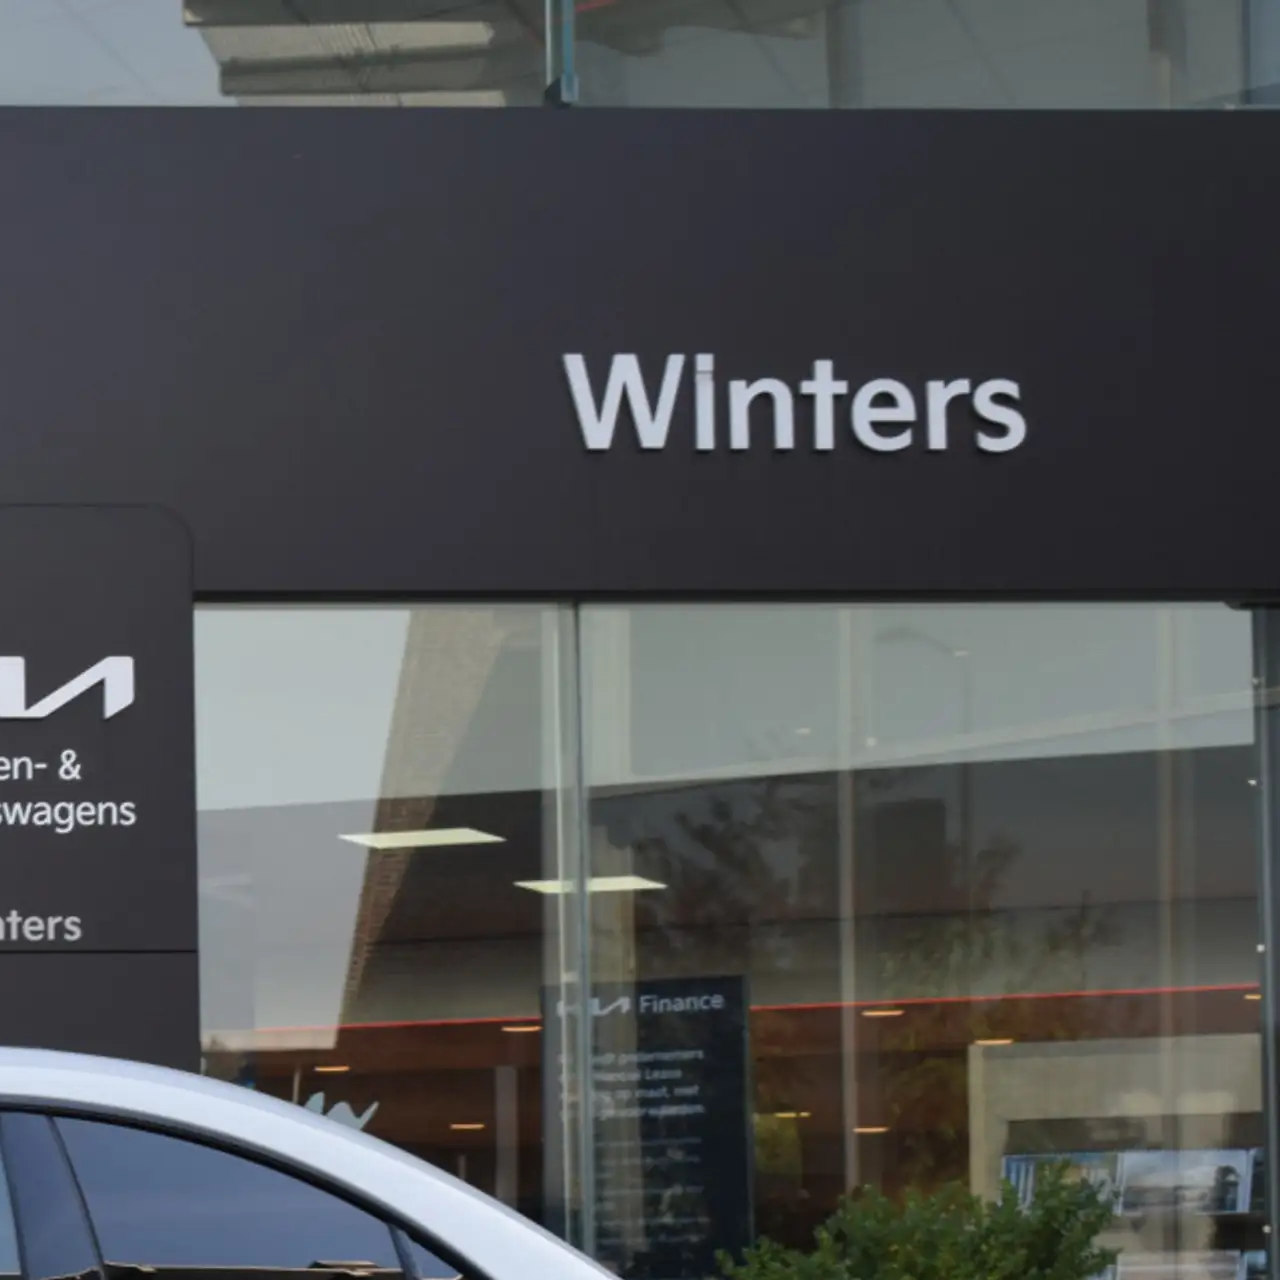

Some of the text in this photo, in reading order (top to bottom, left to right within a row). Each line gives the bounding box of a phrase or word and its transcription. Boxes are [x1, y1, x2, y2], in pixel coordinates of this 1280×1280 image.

[563, 353, 1027, 452] Winters
[57, 748, 82, 781] &
[639, 994, 725, 1014] Finance
